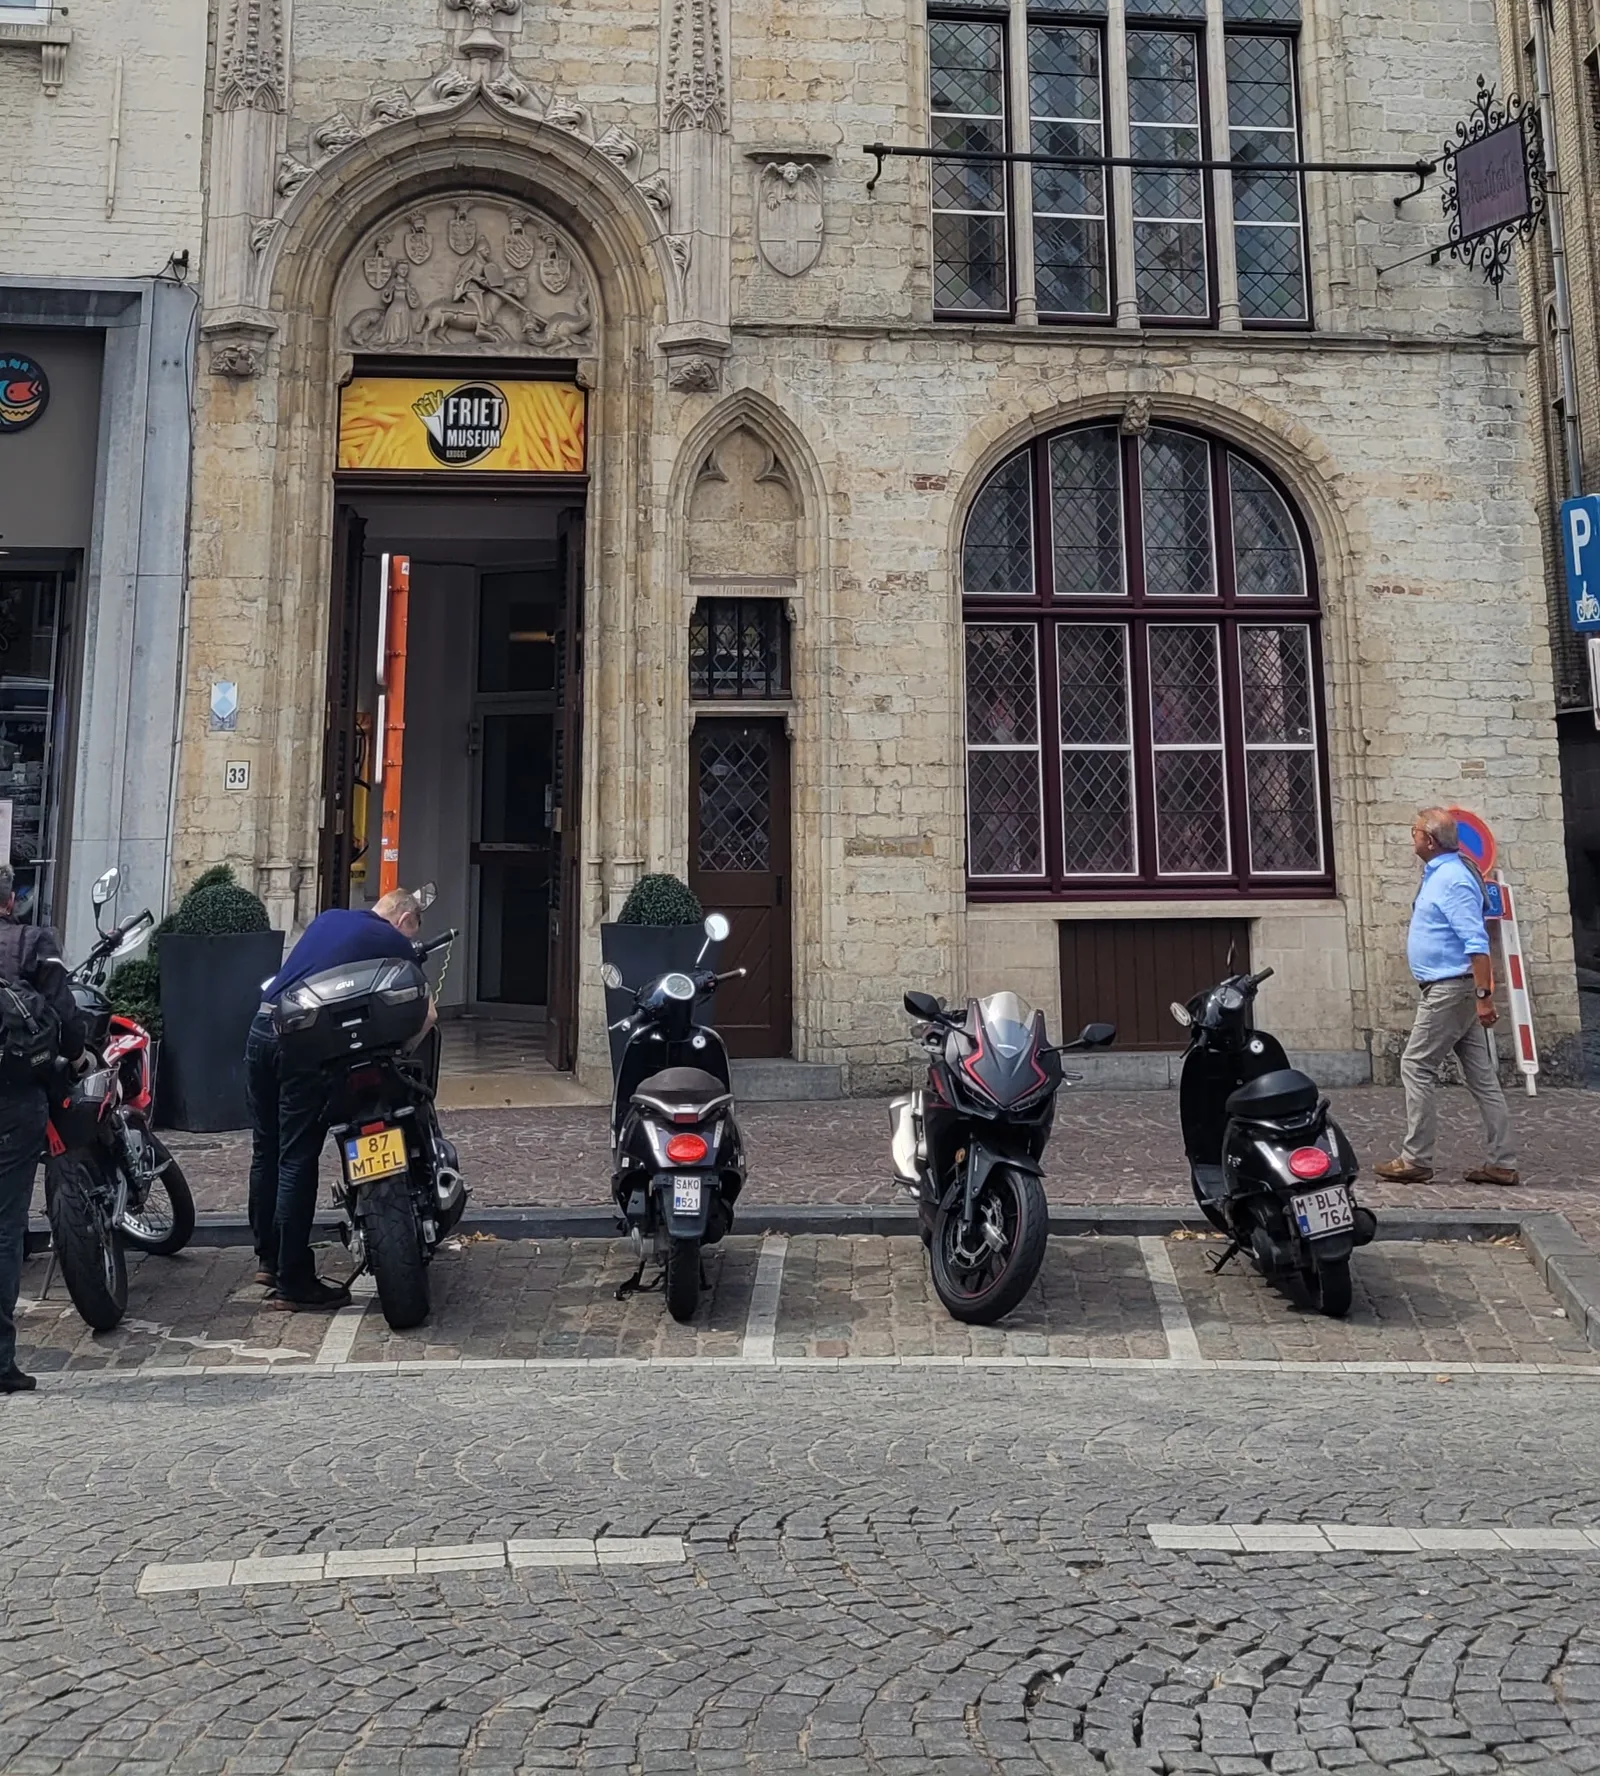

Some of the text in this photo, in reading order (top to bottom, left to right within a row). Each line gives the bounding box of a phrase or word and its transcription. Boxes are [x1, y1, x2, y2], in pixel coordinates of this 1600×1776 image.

[447, 397, 503, 427] FRIET
[446, 429, 500, 447] MUSEUM
[1569, 507, 1592, 576] P
[229, 768, 246, 783] 33
[368, 1134, 389, 1153] 87
[352, 1151, 403, 1177] MT-FL
[681, 1197, 699, 1209] 521
[1320, 1207, 1351, 1228] 764
